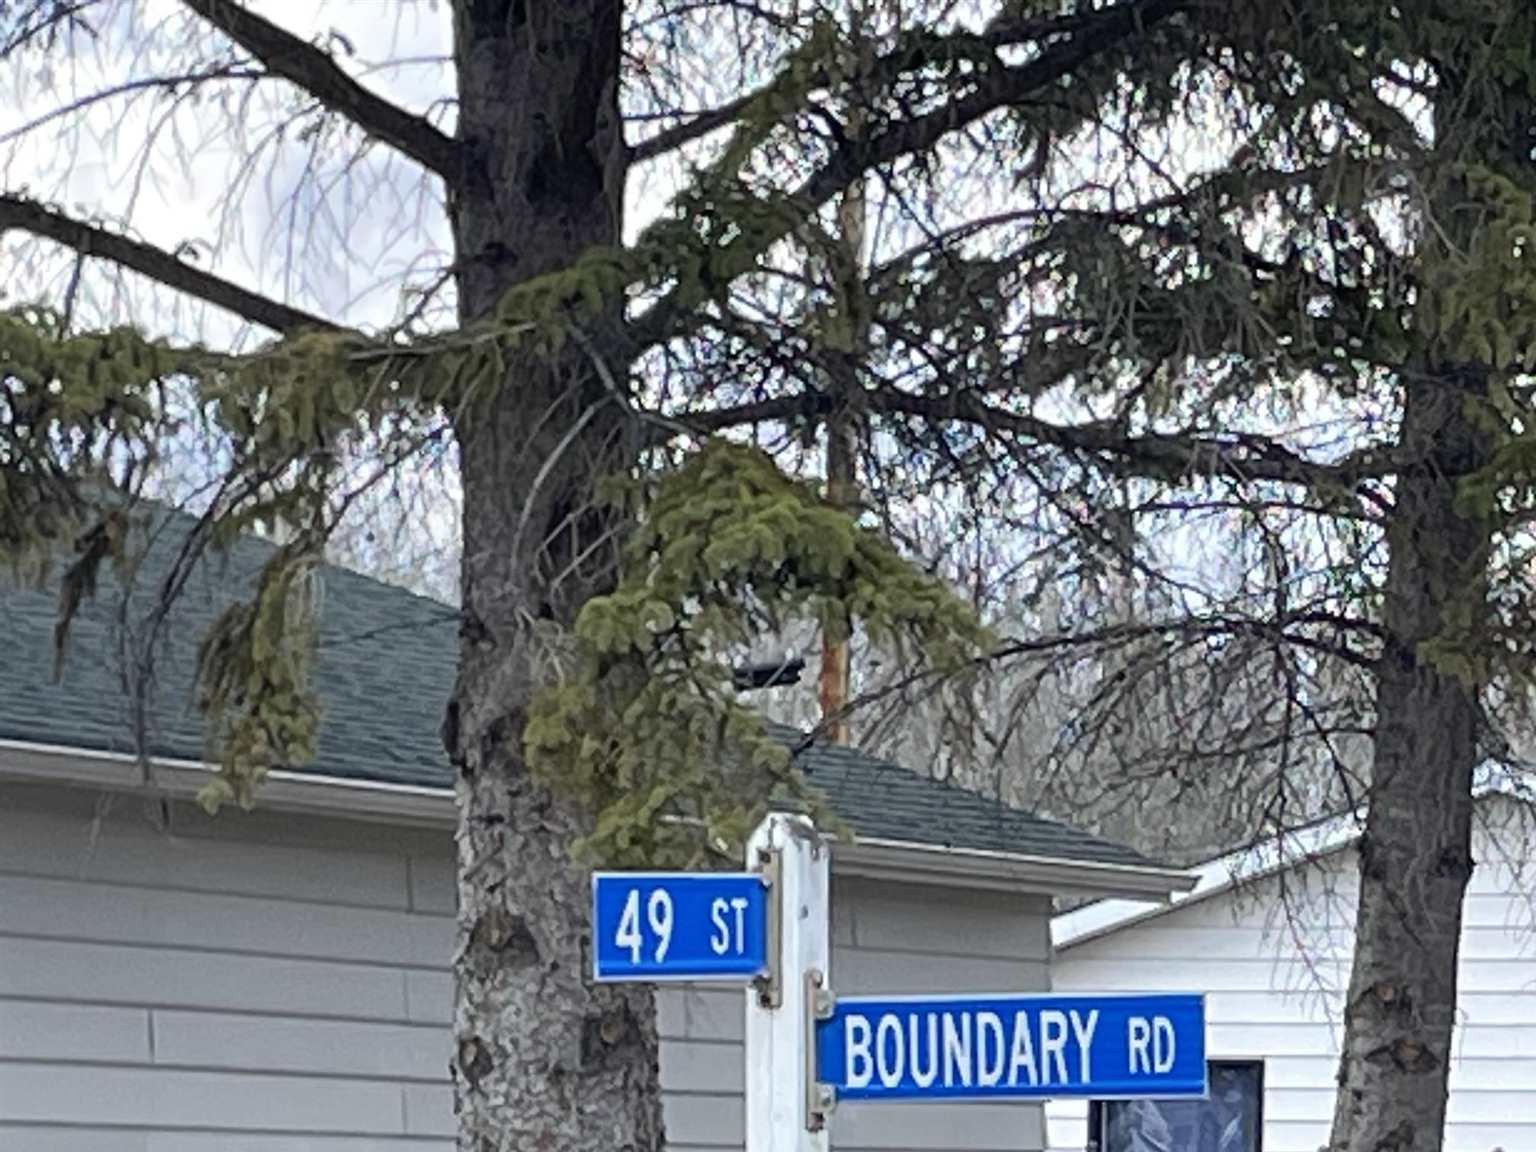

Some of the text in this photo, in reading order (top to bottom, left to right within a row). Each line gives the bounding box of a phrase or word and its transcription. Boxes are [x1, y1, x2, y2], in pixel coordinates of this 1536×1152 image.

[615, 888, 748, 964] 49 ST
[844, 1009, 1176, 1089] BOUNDARY RD
